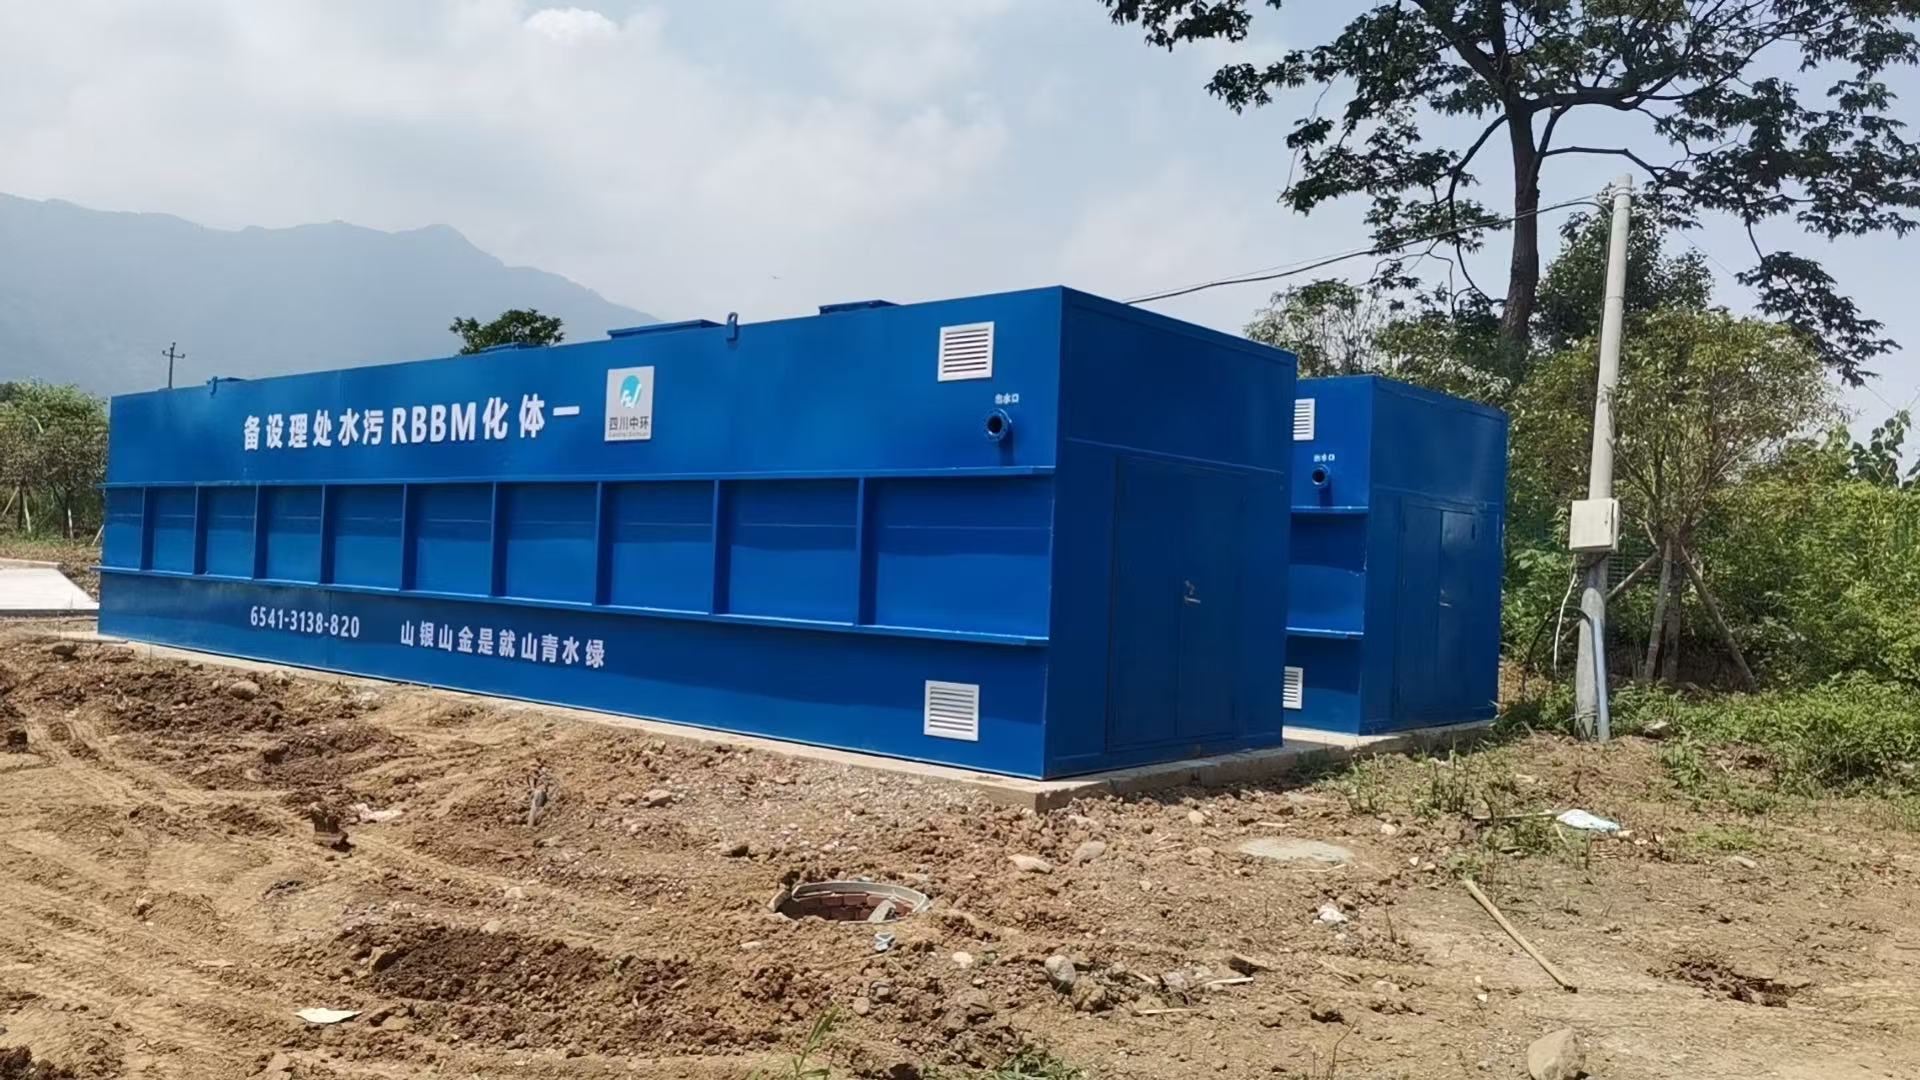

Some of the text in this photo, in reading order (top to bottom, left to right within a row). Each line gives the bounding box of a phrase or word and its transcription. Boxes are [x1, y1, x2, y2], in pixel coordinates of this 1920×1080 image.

[609, 416, 649, 430] 四川中环
[250, 605, 360, 638] 6541-3138-820
[400, 620, 605, 668] 山银山金是就山青水绿
